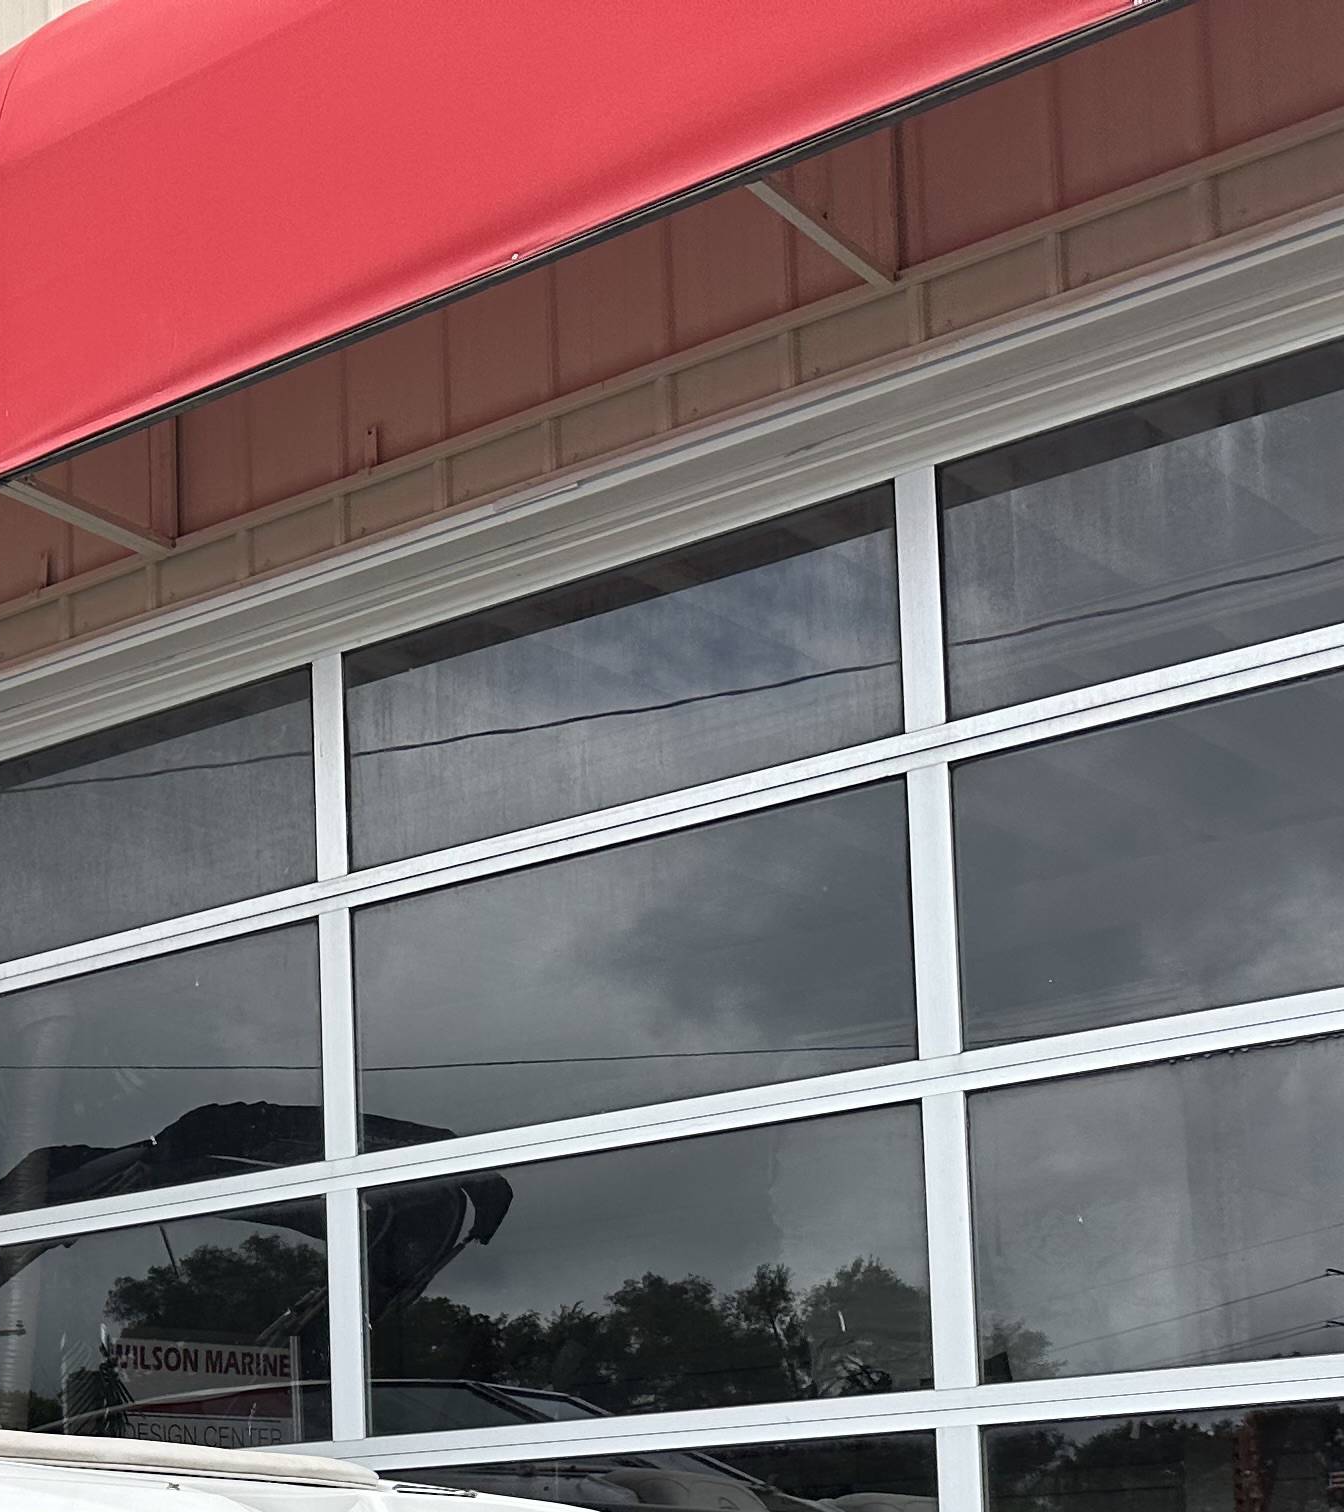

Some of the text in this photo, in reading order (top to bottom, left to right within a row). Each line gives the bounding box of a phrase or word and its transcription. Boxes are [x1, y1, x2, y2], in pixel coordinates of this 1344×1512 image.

[113, 1343, 291, 1378] WILSON MARINE
[126, 1421, 282, 1449] DESIGN CENTER
